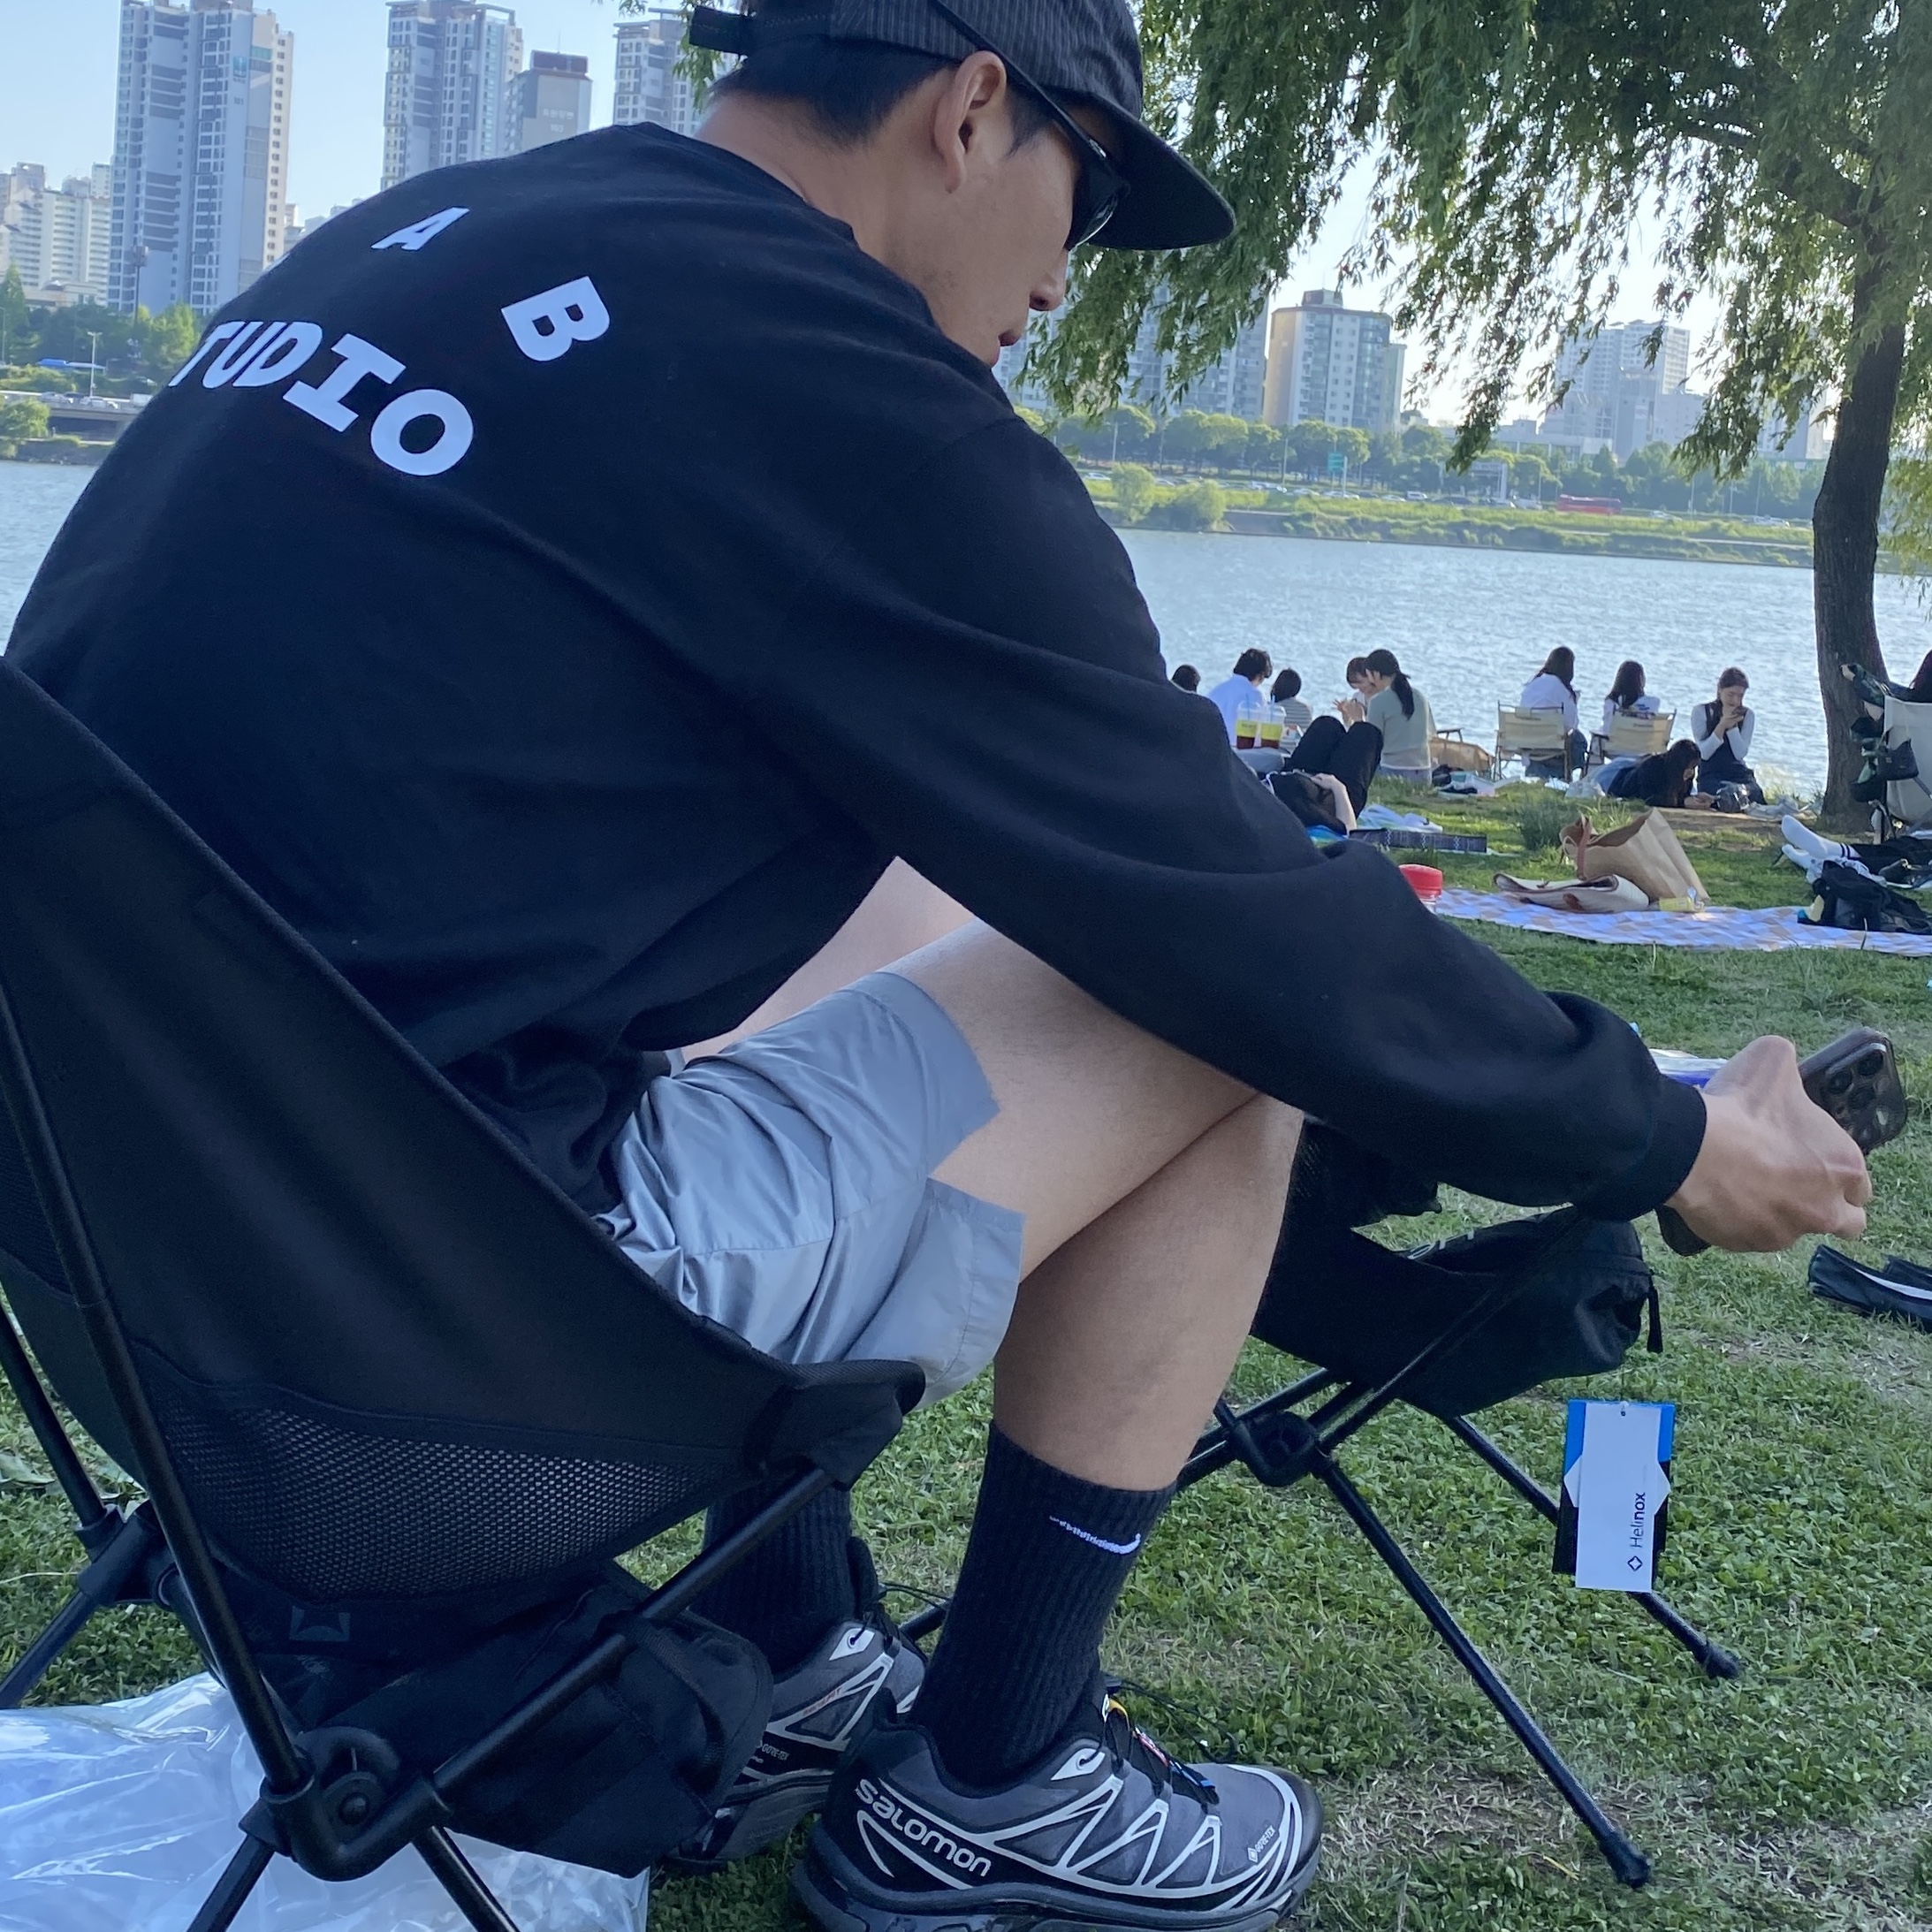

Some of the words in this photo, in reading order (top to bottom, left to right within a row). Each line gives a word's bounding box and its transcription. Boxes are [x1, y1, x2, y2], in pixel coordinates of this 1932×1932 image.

[501, 276, 610, 361] B
[1630, 1492, 1645, 1548] Helinox
[762, 1744, 790, 1761] GORE-TEX
